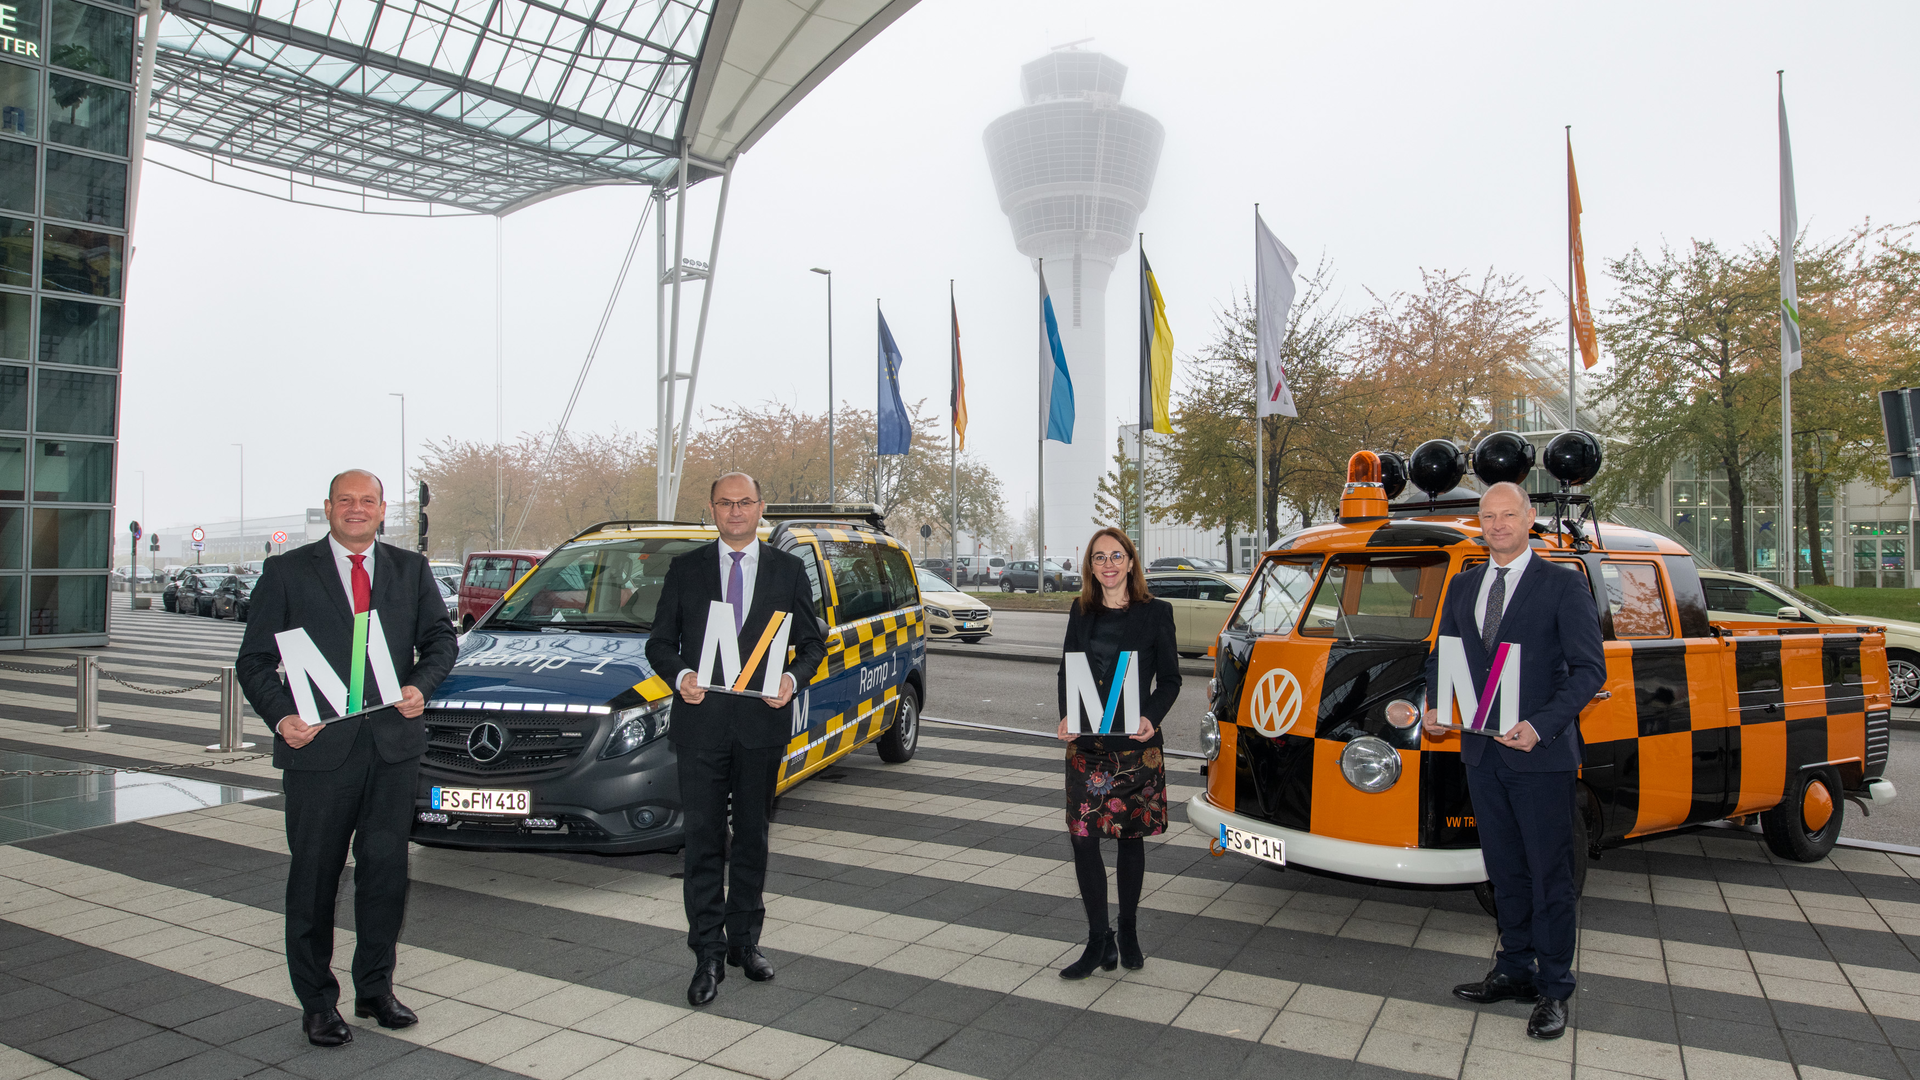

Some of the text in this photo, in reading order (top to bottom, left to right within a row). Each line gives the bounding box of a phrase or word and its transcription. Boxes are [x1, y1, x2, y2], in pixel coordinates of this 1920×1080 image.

[0, 34, 40, 58] TER
[274, 608, 403, 726] M
[454, 651, 614, 675] Ramp 1
[697, 600, 794, 698] M
[859, 661, 889, 695] Ramp
[891, 650, 898, 677] 1
[1065, 651, 1141, 734] M
[1437, 635, 1521, 736] M
[791, 689, 810, 737] M
[1250, 668, 1302, 738] VW
[441, 790, 527, 811] FS FM 418
[1445, 816, 1462, 828] VW
[1226, 829, 1243, 850] FS
